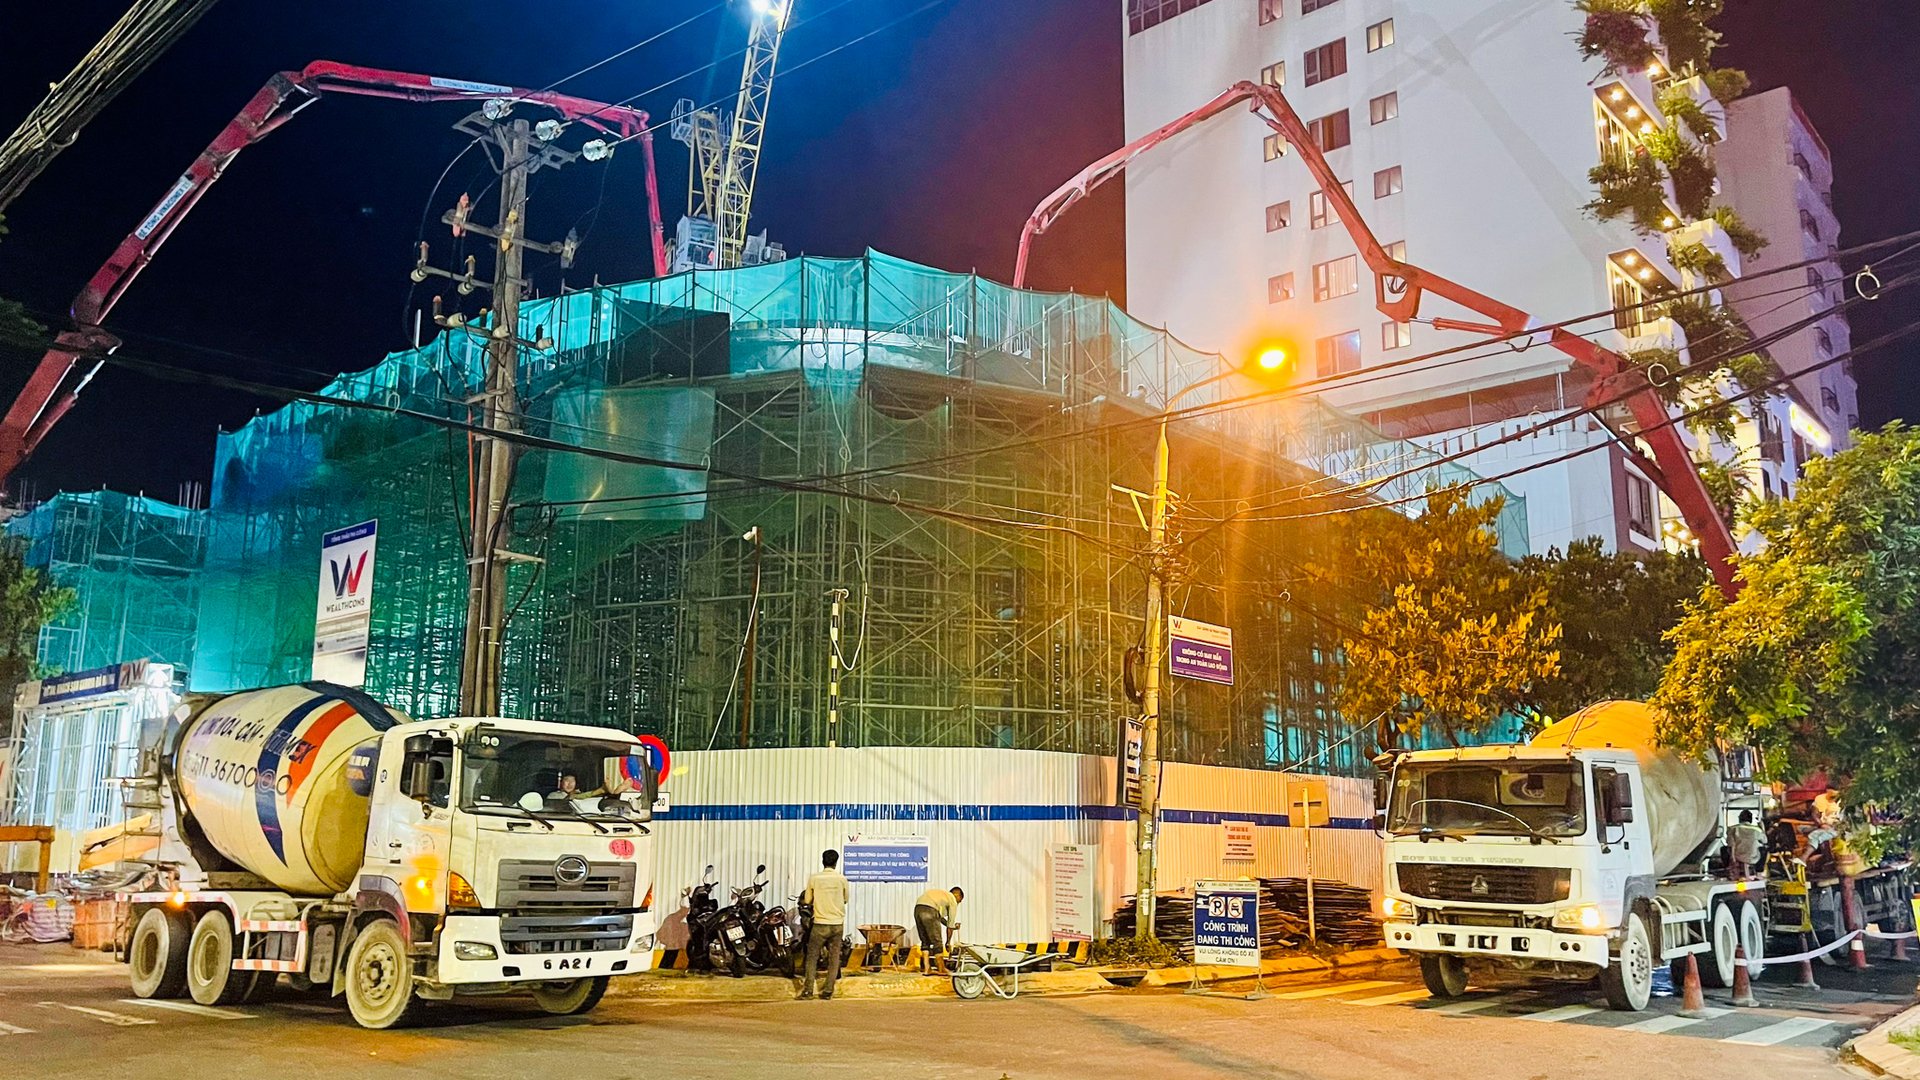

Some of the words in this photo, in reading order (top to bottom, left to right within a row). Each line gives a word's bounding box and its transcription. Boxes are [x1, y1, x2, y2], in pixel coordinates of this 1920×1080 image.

[326, 597, 365, 613] WEALTHCONS
[1203, 920, 1226, 932] CÔNG
[1227, 921, 1249, 933] TRÌNH
[1197, 935, 1219, 945] ĐANG
[1220, 936, 1233, 945] THI
[1234, 935, 1256, 947] CÔNG
